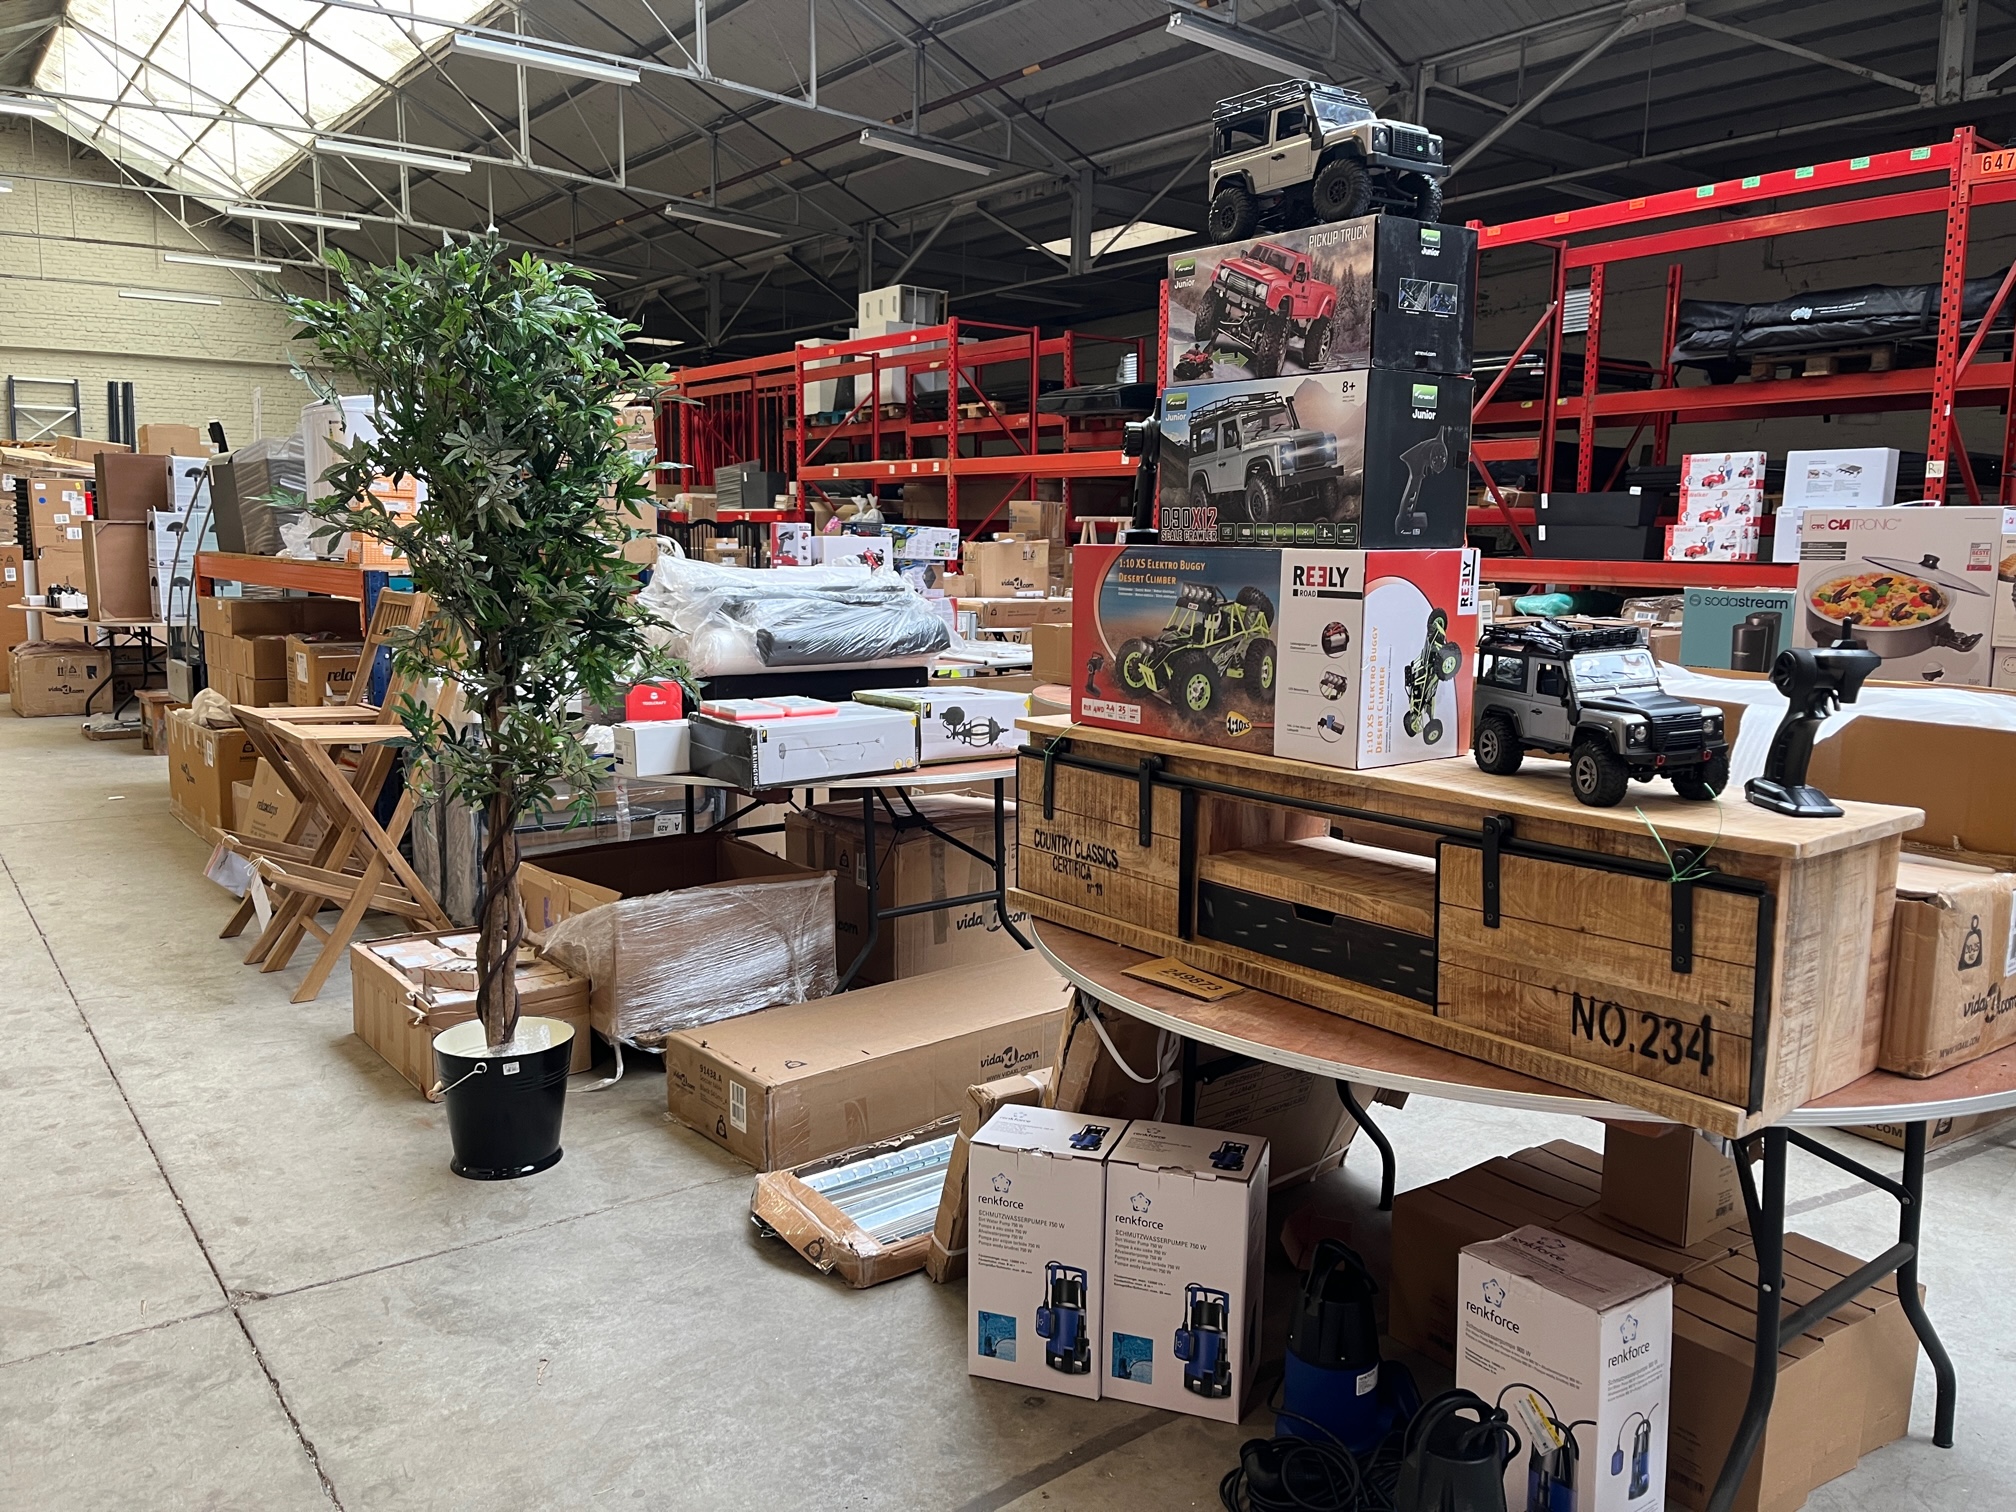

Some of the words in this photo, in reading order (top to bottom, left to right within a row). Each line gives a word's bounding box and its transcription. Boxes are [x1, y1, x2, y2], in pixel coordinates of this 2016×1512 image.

[1983, 152, 2015, 172] 647
[1309, 231, 1338, 248] PICKUP
[1340, 225, 1368, 242] TRUCK
[1421, 247, 1440, 256] Junior
[1174, 279, 1196, 289] Junior
[1342, 380, 1356, 393] 8+
[1166, 413, 1186, 422] Junior
[1412, 409, 1436, 420] Junior
[1162, 507, 1218, 530] D90X12
[1161, 530, 1182, 541] SCALE
[1184, 530, 1218, 542] CRAWLER
[1120, 559, 1134, 568] 1:10
[1136, 559, 1145, 568] XS
[1293, 566, 1349, 587] REELY
[1460, 561, 1471, 607] REELY
[1300, 589, 1316, 598] ROAD
[1704, 595, 1788, 609] sodastream
[1367, 714, 1374, 728] XS
[1034, 828, 1073, 856] COUNTRY
[1075, 840, 1118, 870] CLASSICS
[978, 1195, 1024, 1210] renkforce
[978, 1209, 1047, 1226] SCHMUTZWASSERPUMPE
[1115, 1214, 1164, 1230] renkforce
[1115, 1229, 1187, 1247] SCHMUTZWASSERPUMPE
[1466, 1301, 1520, 1334] renkforce
[1608, 1341, 1650, 1368] renkforce
